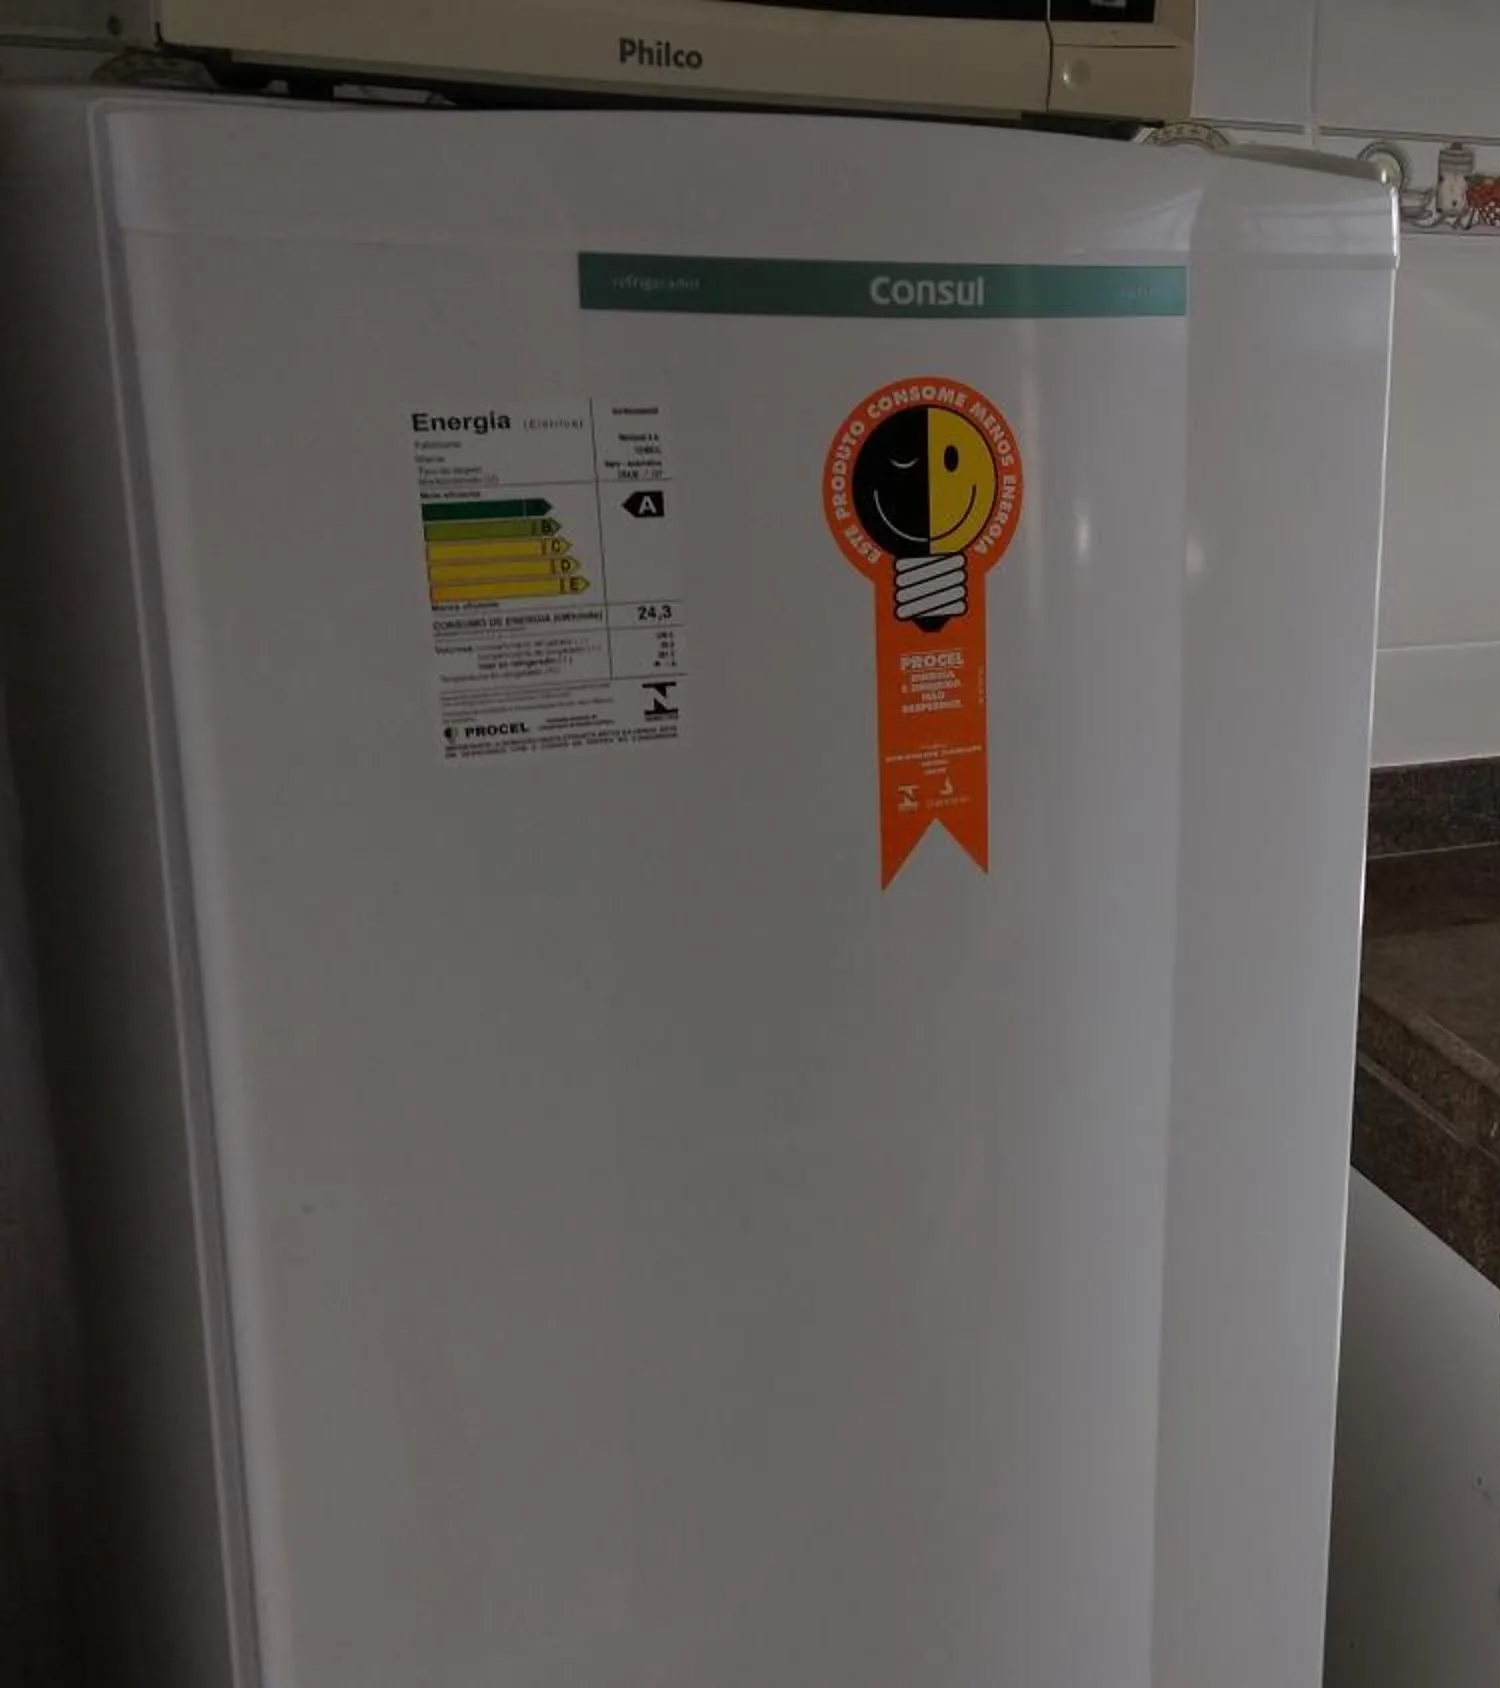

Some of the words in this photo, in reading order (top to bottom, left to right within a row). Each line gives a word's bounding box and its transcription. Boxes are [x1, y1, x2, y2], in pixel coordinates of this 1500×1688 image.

[619, 37, 703, 69] Philco
[869, 275, 985, 307] Consul
[866, 385, 968, 418] CONSOME
[411, 410, 512, 434] Energia
[969, 403, 1014, 466] MENOS
[832, 420, 864, 520] PRODUTO
[638, 496, 658, 514] A
[974, 474, 1016, 554] ENERGIA
[844, 525, 882, 564] ESTE
[570, 577, 579, 591] E
[637, 605, 672, 620] 24,3
[900, 653, 964, 671] PROCEL
[464, 722, 529, 738] PROCEL
